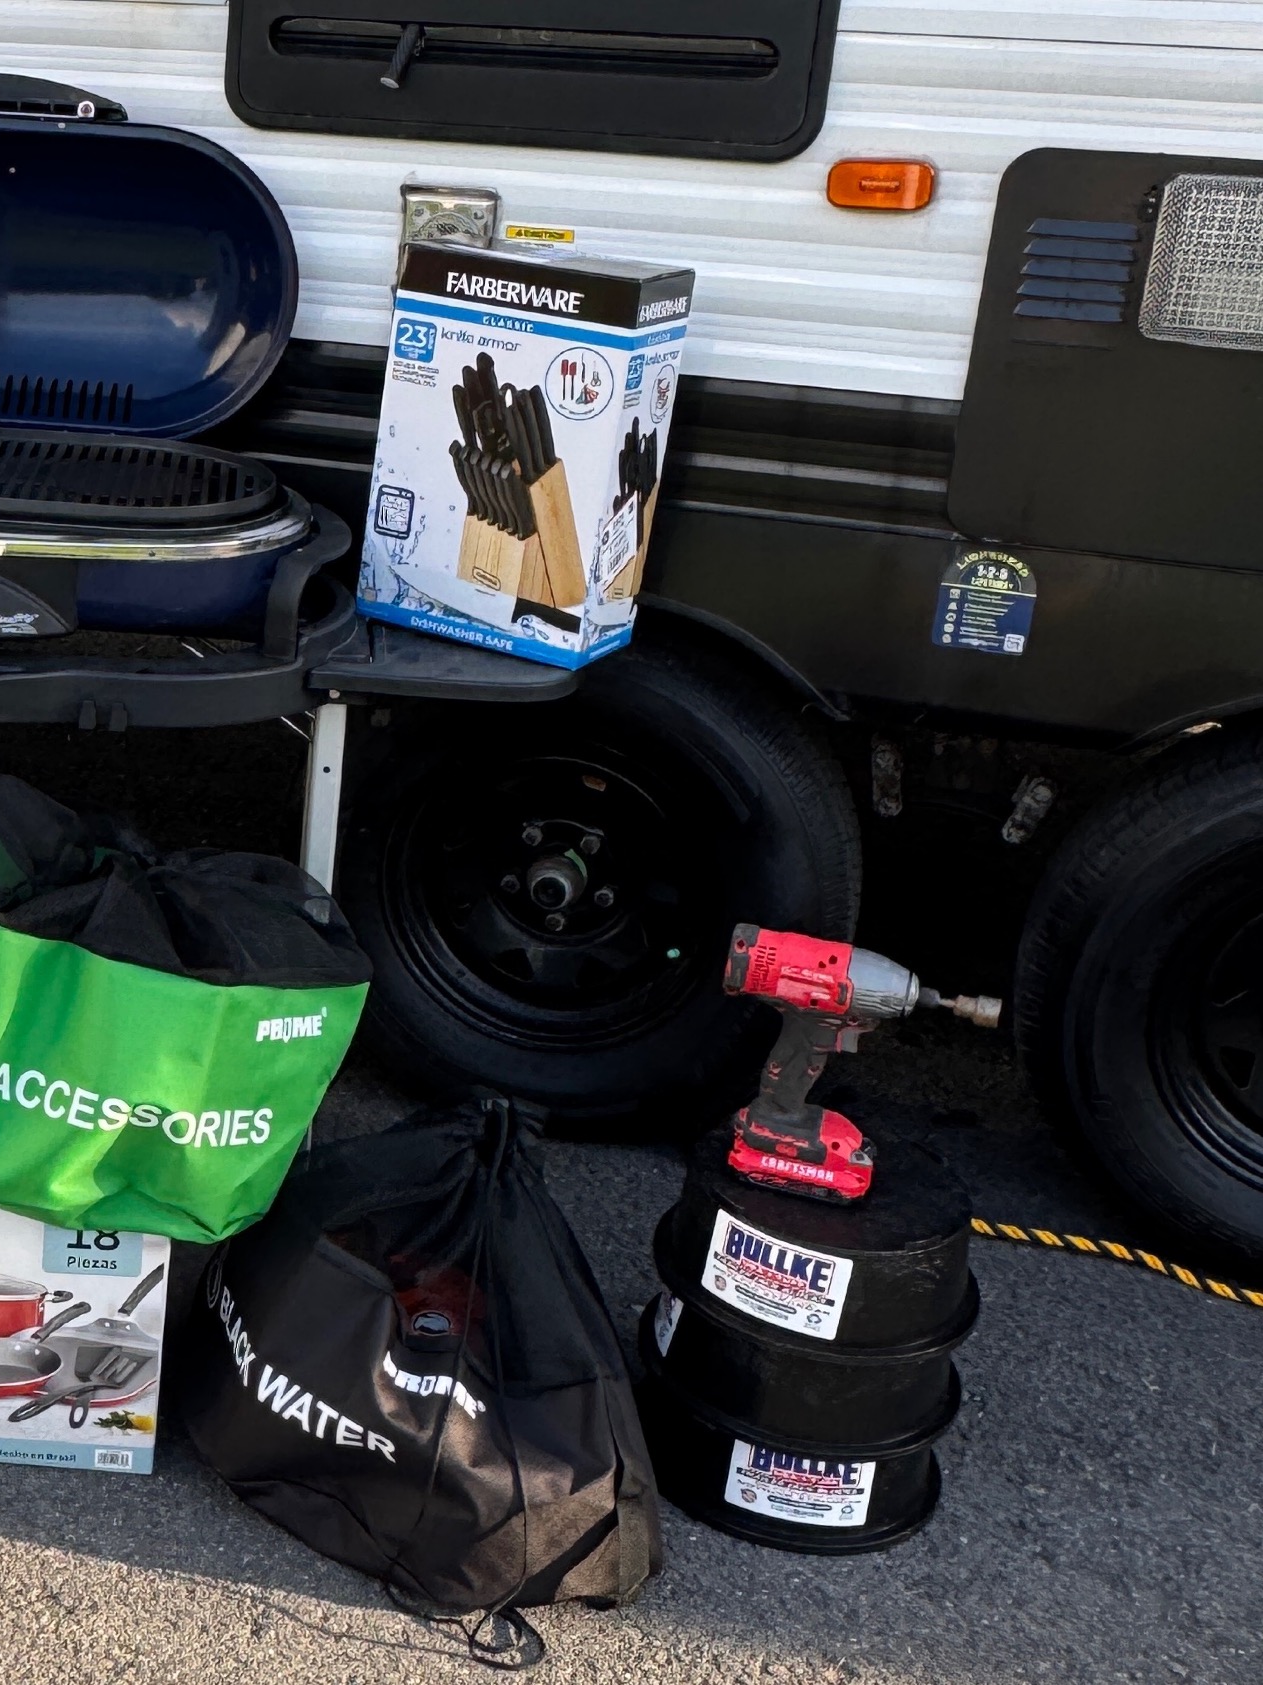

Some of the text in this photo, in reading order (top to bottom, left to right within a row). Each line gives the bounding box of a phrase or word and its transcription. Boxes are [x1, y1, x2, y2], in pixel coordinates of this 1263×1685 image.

[446, 272, 585, 313] FARBERWARE
[398, 323, 428, 349] 23
[67, 1256, 117, 1270] Piezas
[725, 1225, 833, 1293] BULLKE
[257, 1364, 397, 1463] WATER
